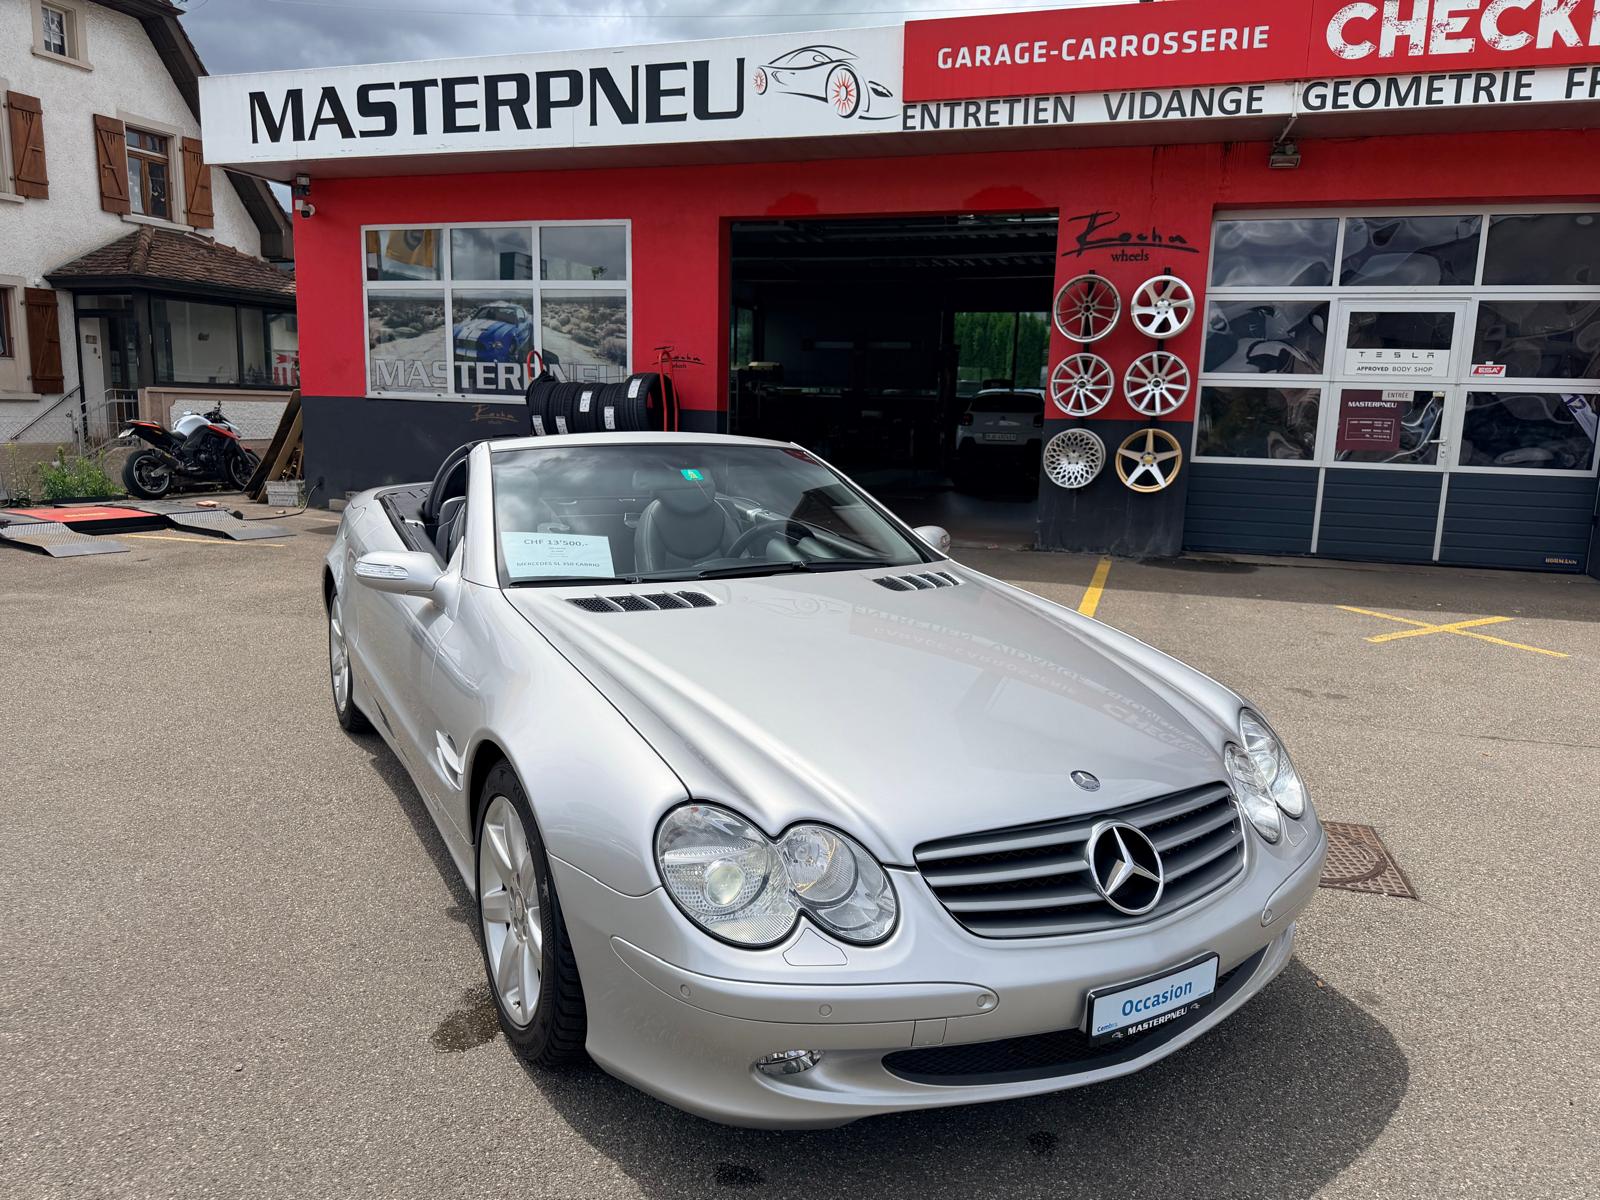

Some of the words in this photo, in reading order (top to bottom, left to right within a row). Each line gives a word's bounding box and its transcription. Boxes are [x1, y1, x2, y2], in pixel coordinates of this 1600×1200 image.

[937, 25, 1270, 69] GARAGE-CARROSSERIE
[1326, 0, 1600, 59] CHECK
[248, 57, 746, 144] MASTERPNEU
[902, 95, 1075, 131] ENTRETIEN
[1102, 85, 1265, 121] VIDANGE
[1302, 69, 1535, 111] GEOMETRIE
[1111, 249, 1149, 262] wheels
[1359, 351, 1435, 359] TESLA
[1121, 981, 1193, 1017] Occasion
[1127, 1006, 1188, 1036] MASTERPNEU
